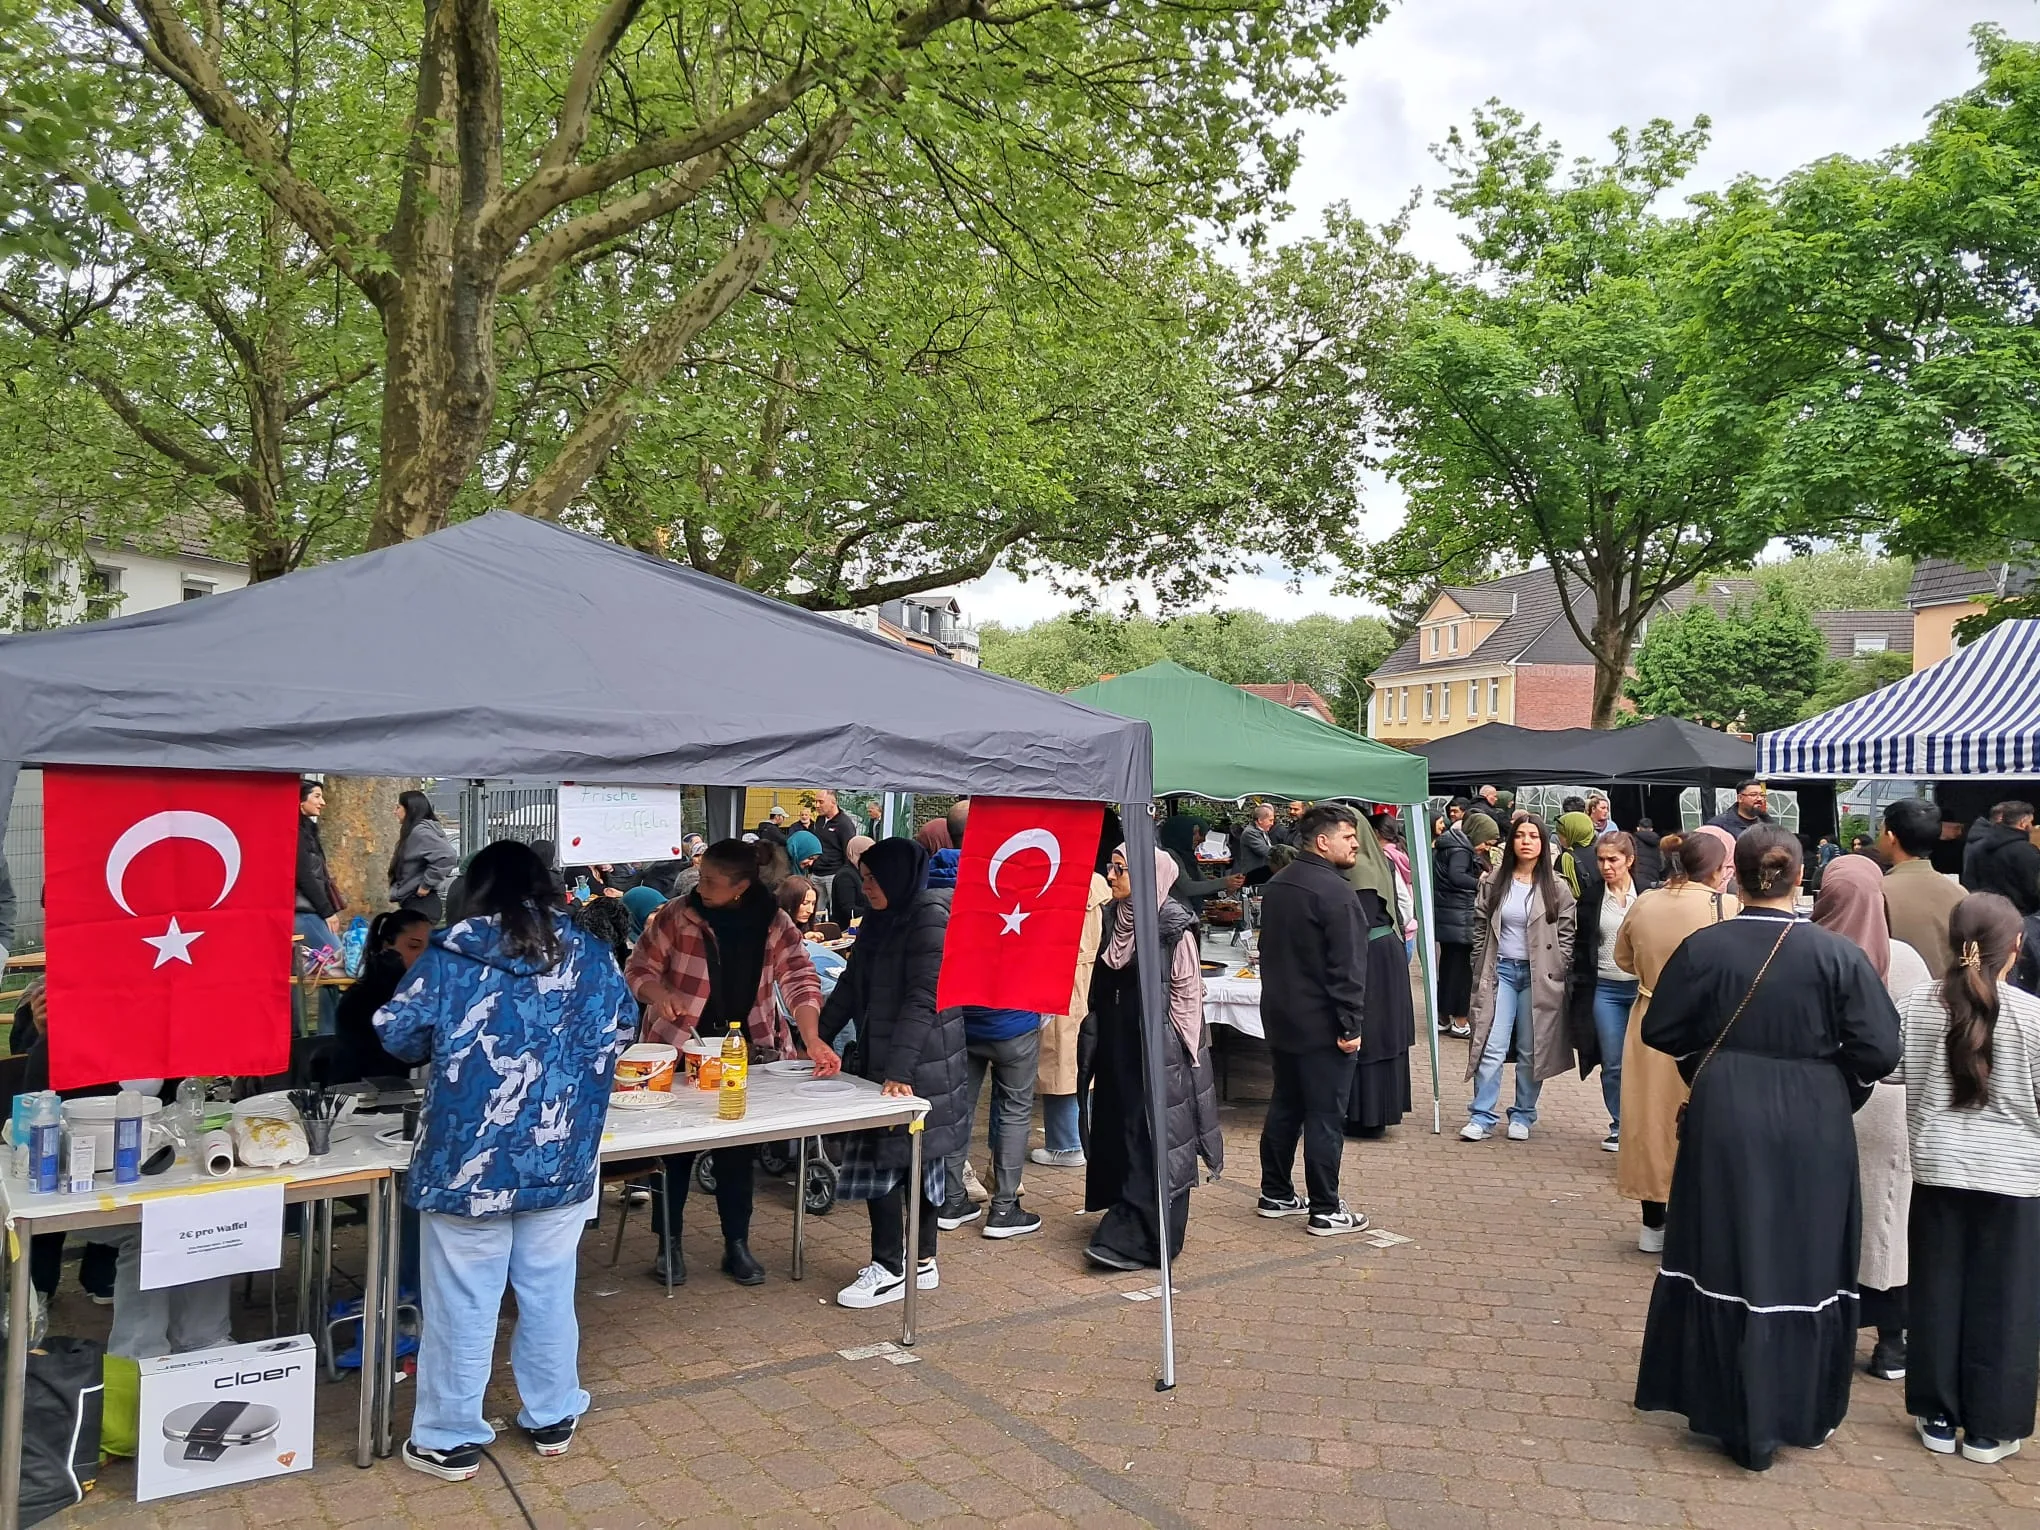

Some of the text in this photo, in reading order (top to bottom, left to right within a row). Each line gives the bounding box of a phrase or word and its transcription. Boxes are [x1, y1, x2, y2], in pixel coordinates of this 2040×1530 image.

[581, 784, 638, 802] Frische
[603, 810, 669, 837] Waffeln
[179, 1221, 248, 1240] 2€ pro Waffel
[214, 1365, 301, 1390] cloer
